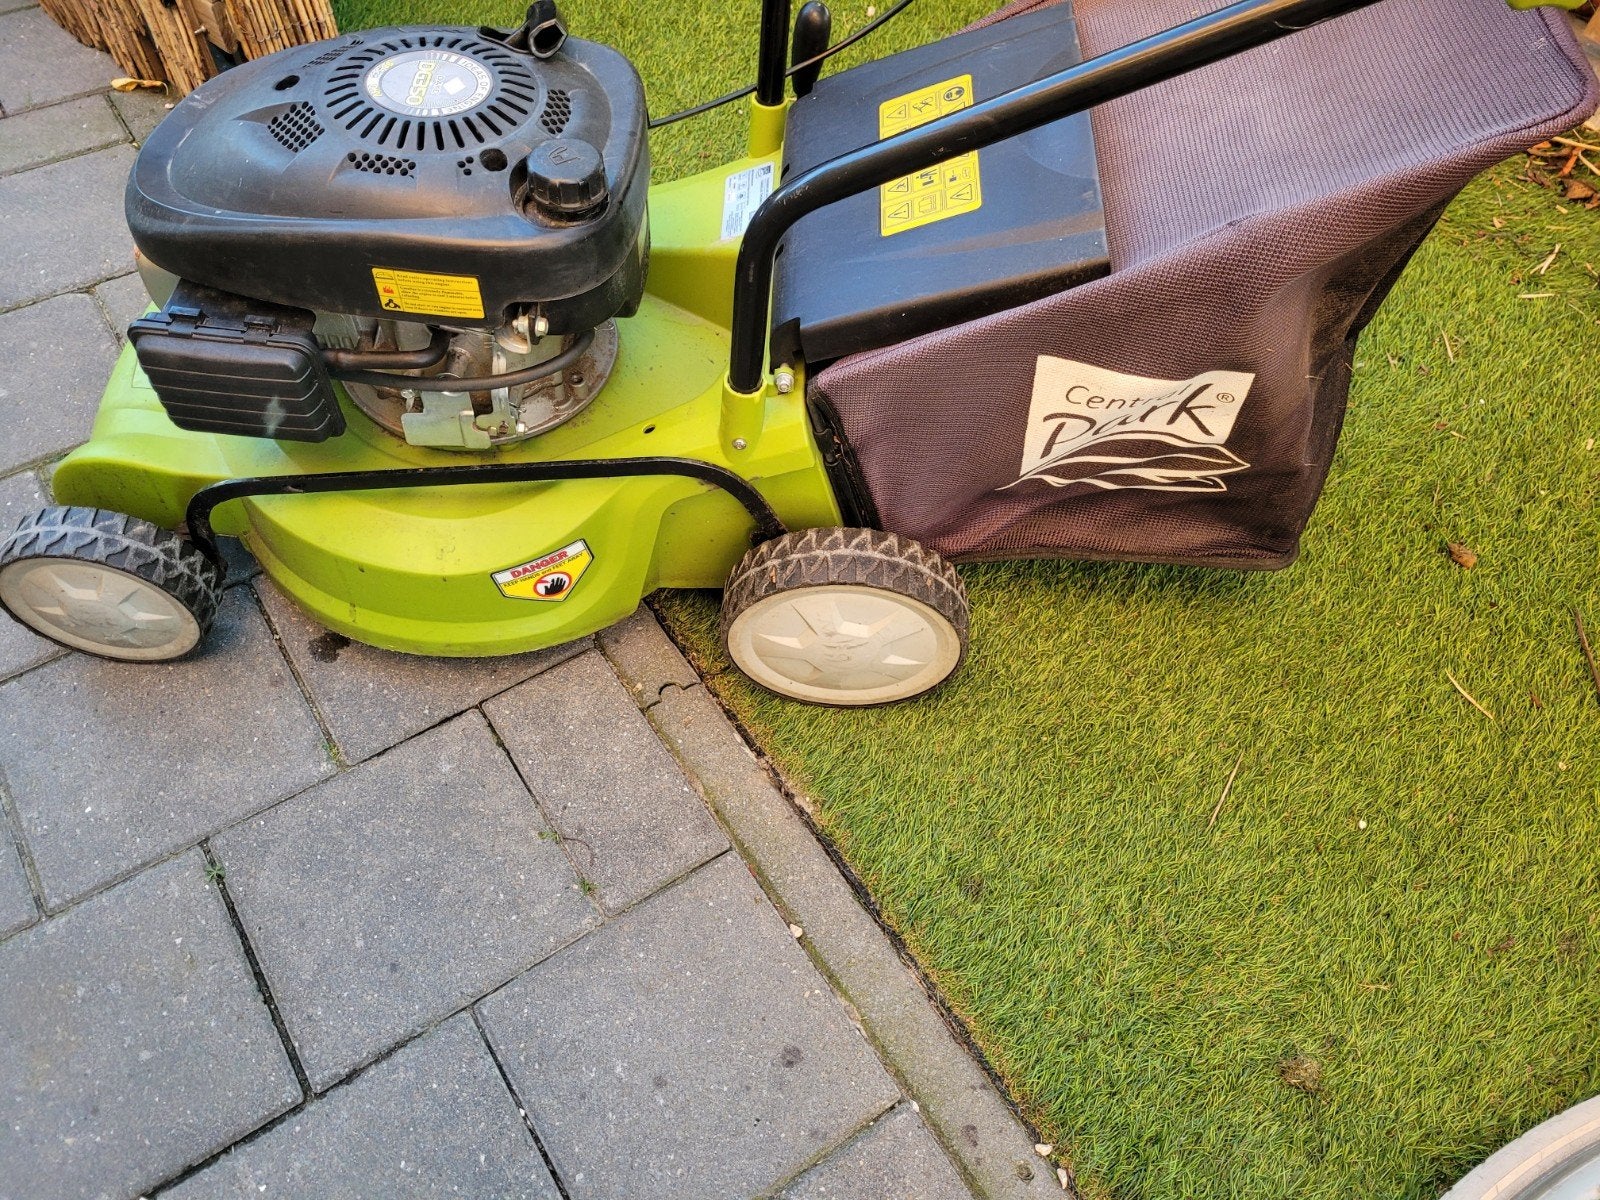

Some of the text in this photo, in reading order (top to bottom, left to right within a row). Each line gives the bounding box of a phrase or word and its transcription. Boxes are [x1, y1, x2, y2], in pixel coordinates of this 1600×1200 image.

[462, 60, 487, 79] IDEAS
[481, 81, 489, 92] OF
[1040, 383, 1216, 460] Park
[503, 579, 520, 588] KEEP
[552, 561, 568, 570] FEET
[510, 550, 569, 579] DANGER
